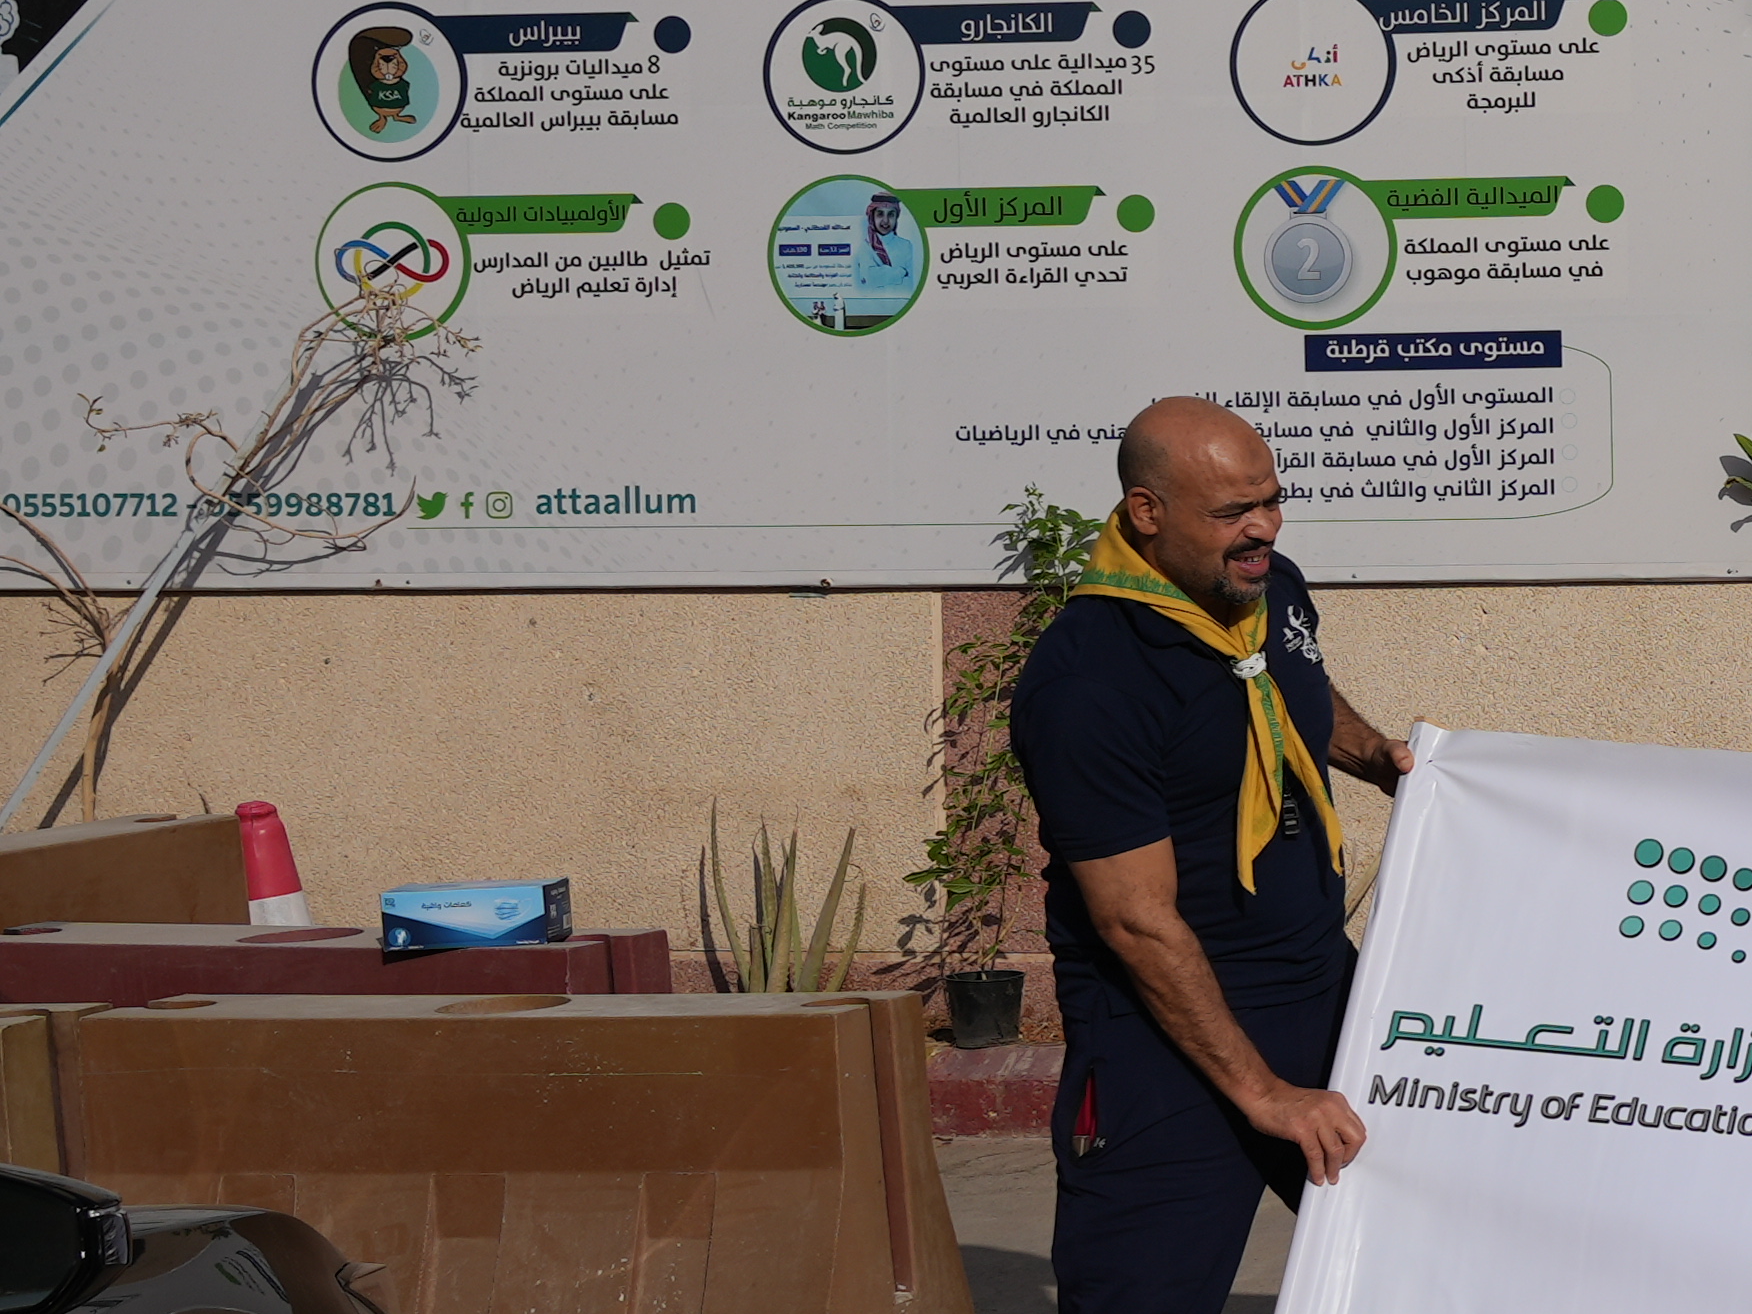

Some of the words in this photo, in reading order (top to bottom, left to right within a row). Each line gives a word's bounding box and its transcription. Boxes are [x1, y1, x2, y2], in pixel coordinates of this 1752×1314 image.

[1380, 2, 1468, 32] الخامس
[1477, 1, 1546, 29] المركز
[509, 19, 581, 48] بيبراس
[961, 12, 1053, 42] الكانجارو
[498, 60, 558, 81] برونزية
[565, 57, 642, 78] ميداليات
[647, 56, 659, 74] 8
[931, 57, 1004, 75] مستوى
[1011, 55, 1051, 70] على
[1058, 55, 1127, 74] ميدالية
[1131, 55, 1155, 74] 35
[1432, 62, 1484, 84] أذكى
[1284, 74, 1341, 88] ATHKA
[1489, 67, 1564, 86] مسابقة
[378, 89, 402, 101] KSA
[474, 86, 544, 105] المملكة
[551, 87, 623, 105] مستوى
[630, 84, 669, 100] على
[931, 83, 1002, 101] مسابقة
[1010, 81, 1044, 100] في
[1050, 80, 1122, 98] المملكة
[1467, 92, 1535, 113] للبرمجة
[460, 113, 533, 133] العالمية
[541, 112, 601, 133] بيبراس
[607, 110, 678, 128] مسابقة
[788, 111, 846, 122] Kangaroo
[848, 110, 894, 119] Mawhiba
[950, 107, 1025, 128] العالمية
[1033, 106, 1109, 127] الكانجارو
[1387, 188, 1459, 208] الفضية
[1466, 185, 1558, 209] الميدالية
[456, 206, 517, 226] الدولية
[474, 252, 548, 273] المدارس
[555, 254, 581, 270] من
[588, 252, 648, 272] طالبين
[659, 249, 710, 270] تمثيل
[512, 278, 569, 298] الرياض
[577, 277, 628, 298] تعليم
[636, 276, 677, 298] إدارة
[1326, 339, 1389, 364] قرطبة
[1397, 337, 1451, 359] مكتب
[1459, 336, 1544, 361] مستوى
[1288, 391, 1360, 411] مسابقة
[1368, 389, 1402, 410] في
[1409, 383, 1455, 410] الأول
[1462, 387, 1554, 409] المستوى
[1322, 451, 1396, 471] مسابقة
[1403, 450, 1437, 471] في
[1444, 444, 1490, 471] الأول
[1498, 448, 1554, 471] المركز
[3, 493, 178, 517] 0555107712
[536, 487, 697, 516] attaallum
[1381, 1004, 1649, 1061] التعليم
[1368, 1075, 1531, 1128] Ministry
[1541, 1092, 1583, 1120] of
